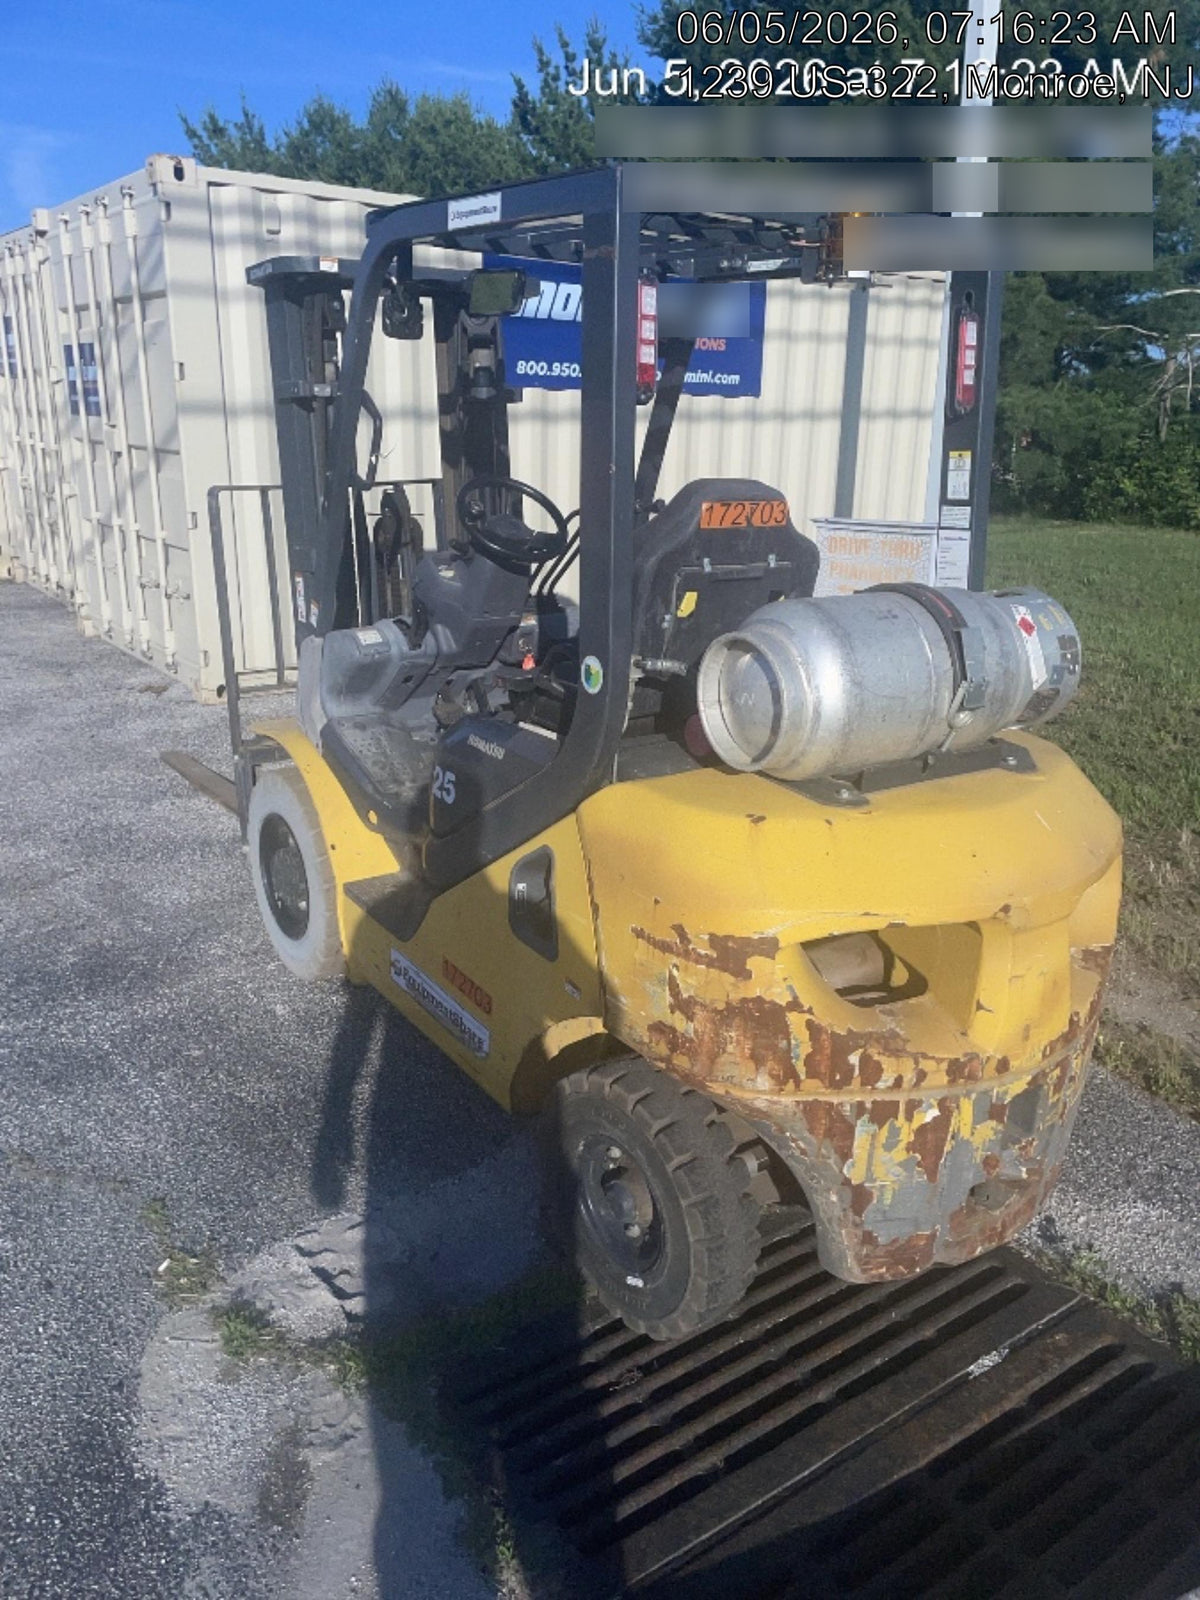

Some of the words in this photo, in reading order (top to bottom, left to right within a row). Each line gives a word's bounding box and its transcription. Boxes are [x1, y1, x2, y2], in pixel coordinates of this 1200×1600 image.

[516, 360, 582, 378] 800.950.
[705, 502, 787, 527] 172703
[827, 536, 870, 555] DRIVE
[432, 765, 456, 805] 25
